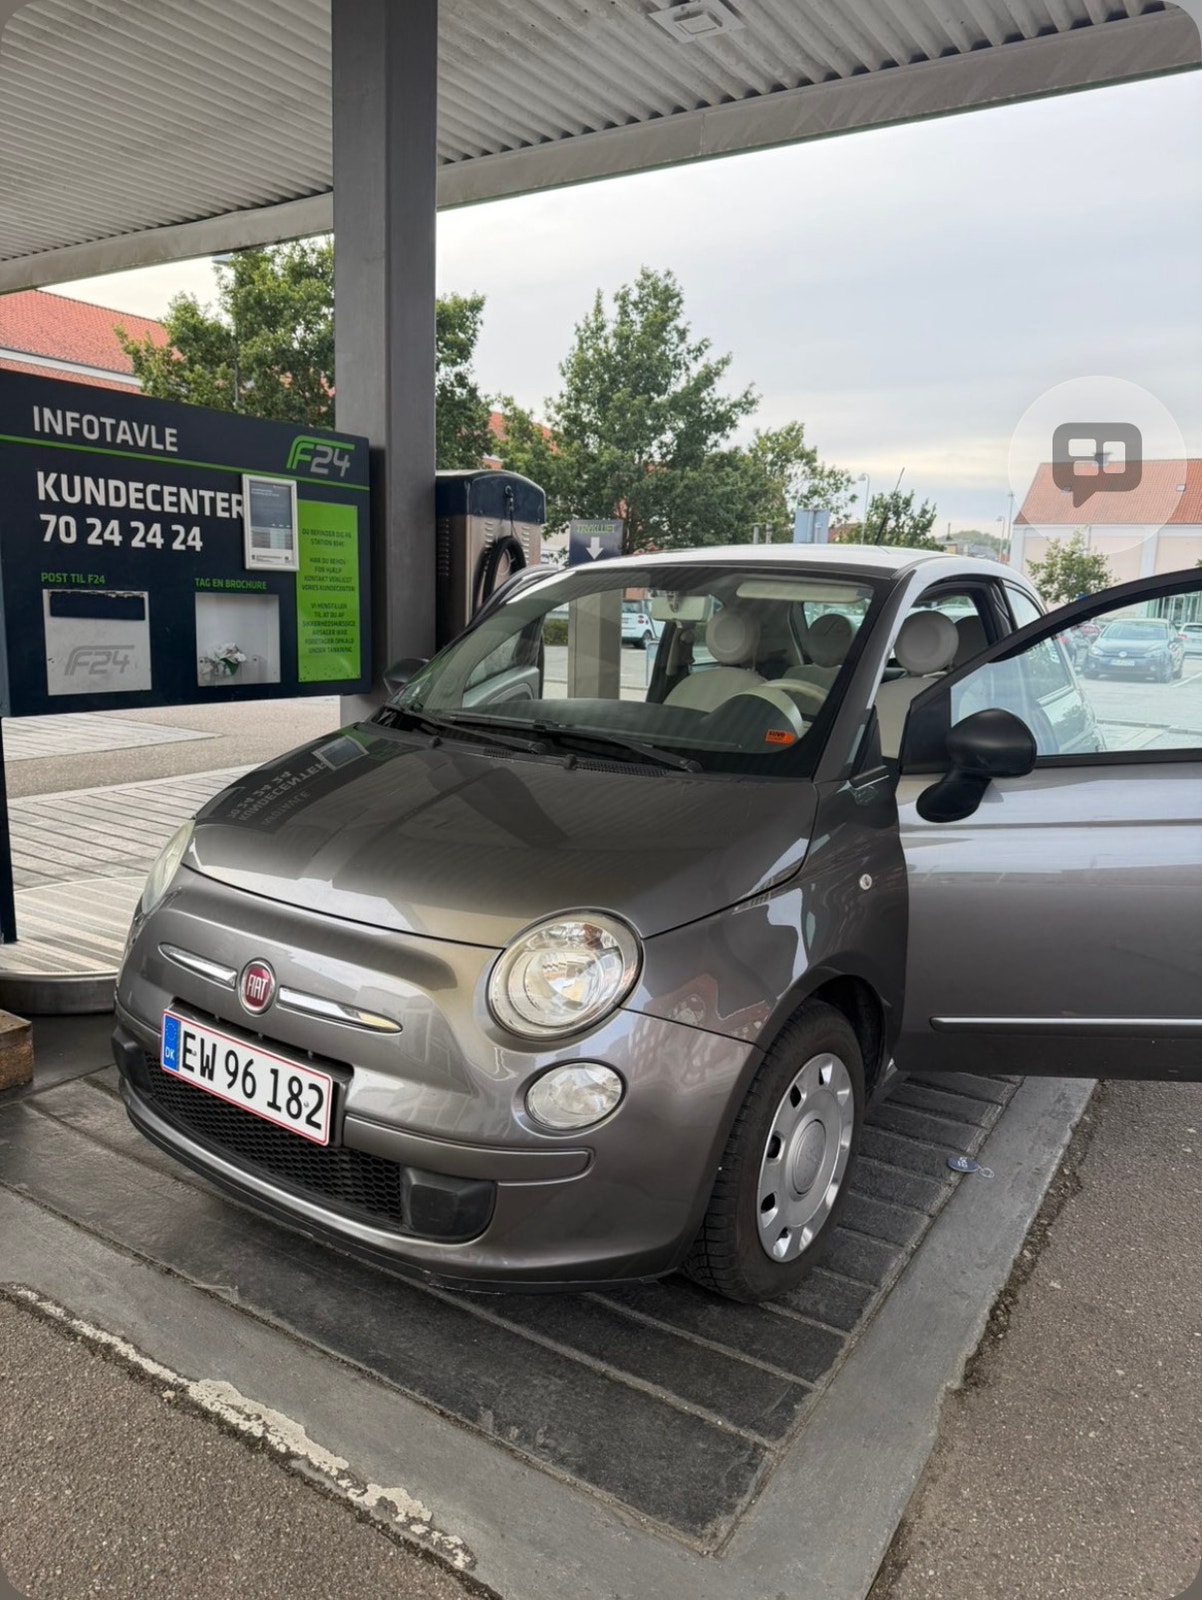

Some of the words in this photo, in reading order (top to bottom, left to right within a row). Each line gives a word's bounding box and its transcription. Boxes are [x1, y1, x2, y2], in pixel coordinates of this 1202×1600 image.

[33, 405, 178, 452] INFOTAVLE
[286, 435, 356, 478] F24
[37, 471, 243, 519] KUNDECENTER
[39, 514, 77, 544] 70
[86, 517, 122, 546] 24
[130, 521, 164, 549] 24
[171, 525, 203, 552] 24
[576, 524, 616, 534] TRYKLUFT
[41, 572, 68, 584] POST
[69, 573, 83, 584] TIL
[84, 574, 106, 585] F24
[195, 577, 212, 588] TAG
[213, 578, 224, 589] EN
[225, 579, 267, 590] BROCHURE
[64, 644, 135, 676] F24
[246, 973, 268, 1001] FIAT
[165, 1046, 176, 1061] DK
[182, 1030, 217, 1082] EW
[224, 1050, 257, 1100] 96
[267, 1068, 324, 1131] 182
